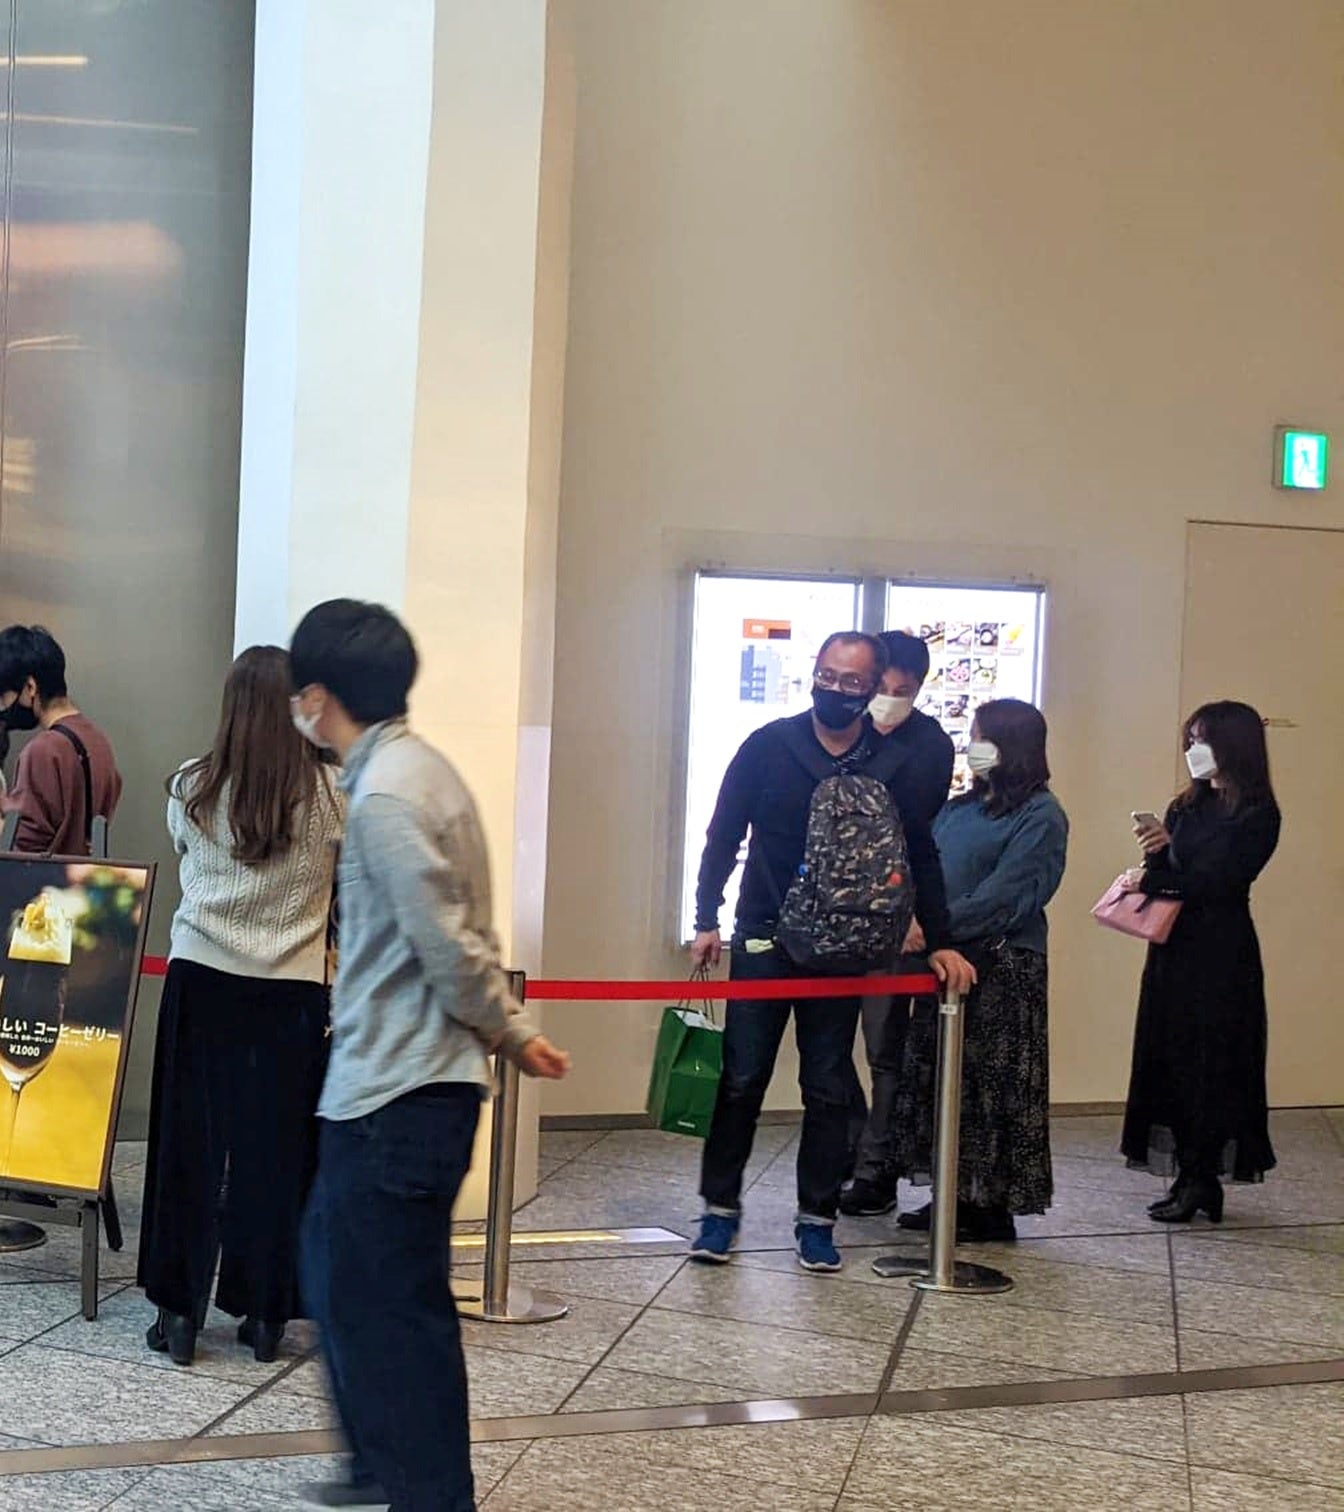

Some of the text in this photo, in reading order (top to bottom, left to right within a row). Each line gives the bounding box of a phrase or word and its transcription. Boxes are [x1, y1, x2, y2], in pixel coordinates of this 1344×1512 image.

[34, 1022, 120, 1042] コーヒーゼリー
[9, 1043, 40, 1057] ¥1000
